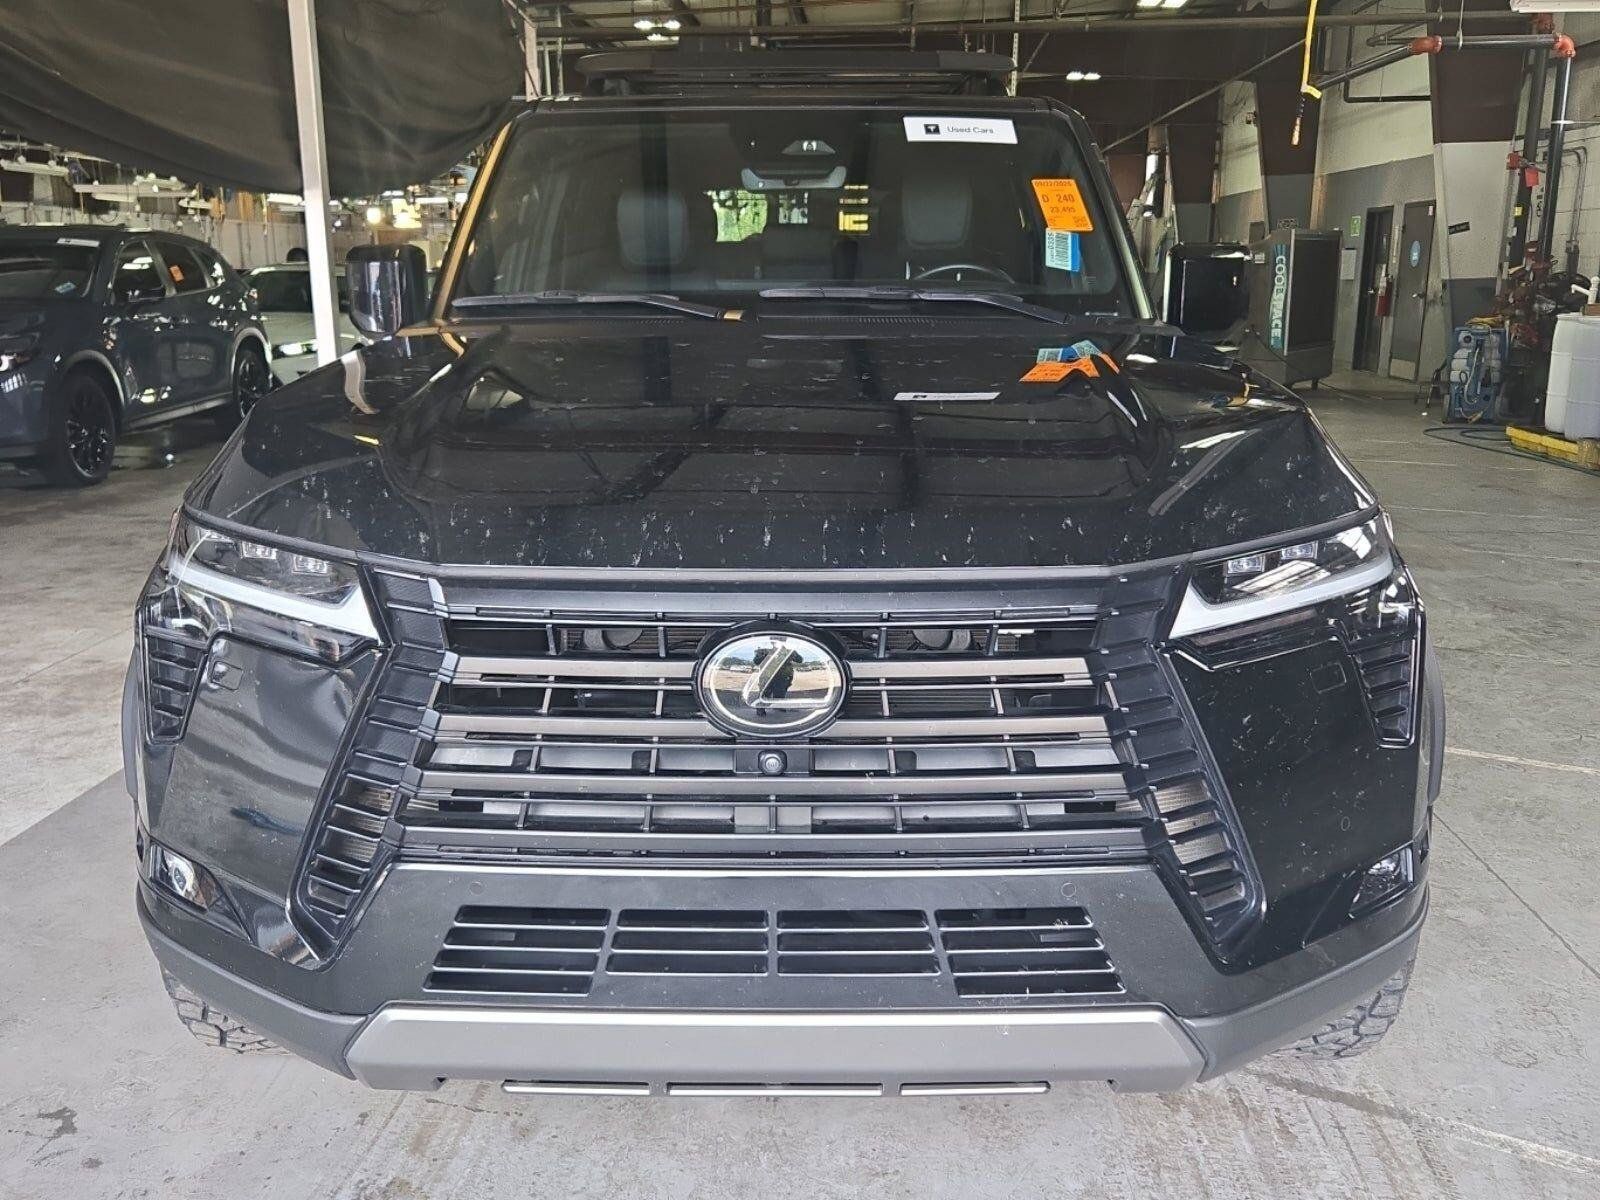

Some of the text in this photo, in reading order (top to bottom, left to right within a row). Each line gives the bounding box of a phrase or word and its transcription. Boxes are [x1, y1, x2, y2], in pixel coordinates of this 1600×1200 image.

[947, 125, 971, 133] Used
[972, 126, 994, 134] Cars
[1055, 193, 1076, 203] 240
